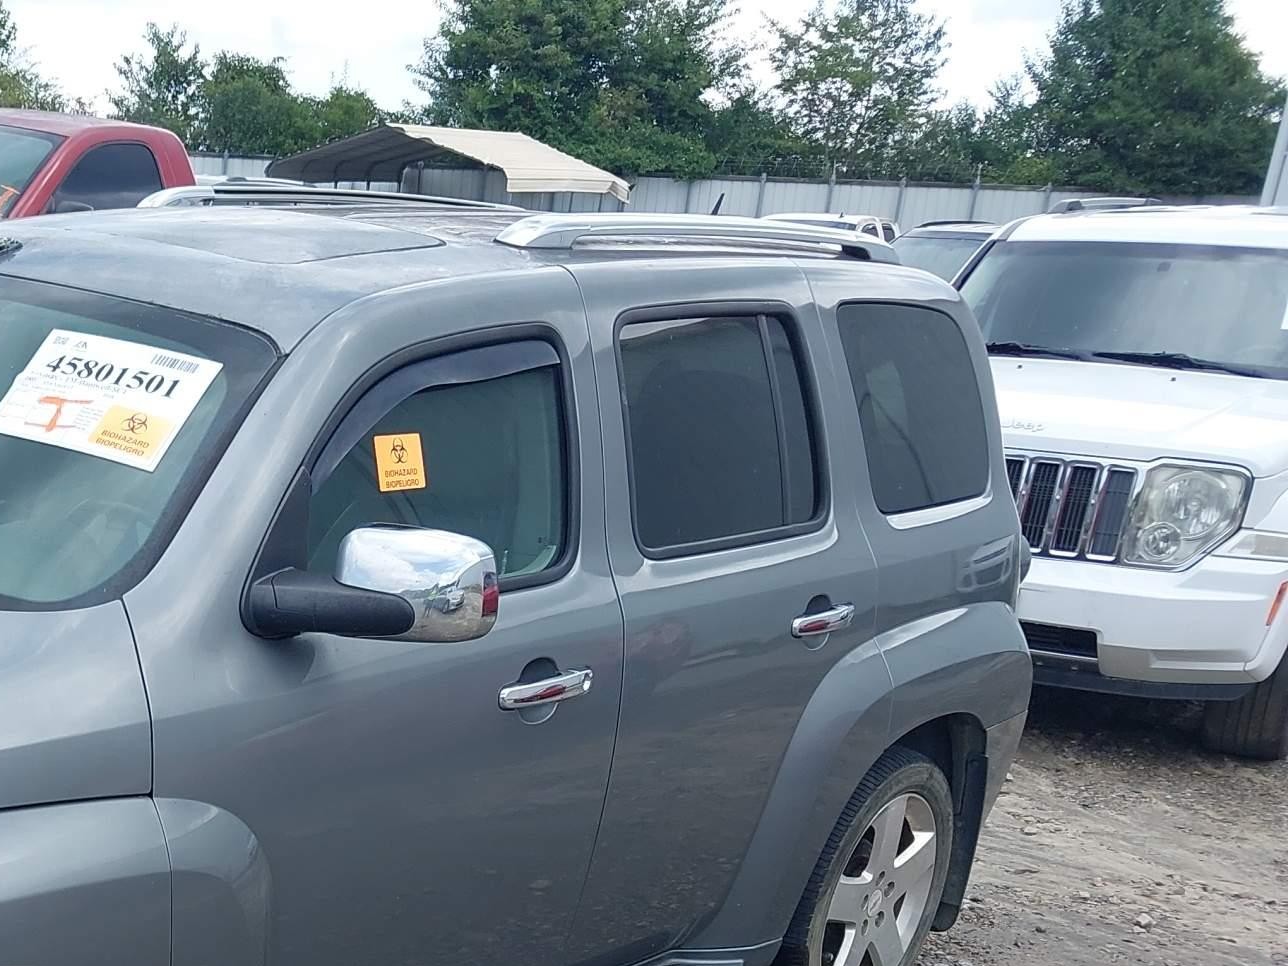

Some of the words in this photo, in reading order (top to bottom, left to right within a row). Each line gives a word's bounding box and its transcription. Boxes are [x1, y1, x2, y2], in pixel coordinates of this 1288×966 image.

[45, 354, 182, 399] 45801501
[1000, 416, 1046, 433] Jeep
[95, 437, 145, 457] BIOPELIGRO
[101, 429, 150, 449] BIOHAZARD
[384, 468, 418, 478] BIOHAZARD
